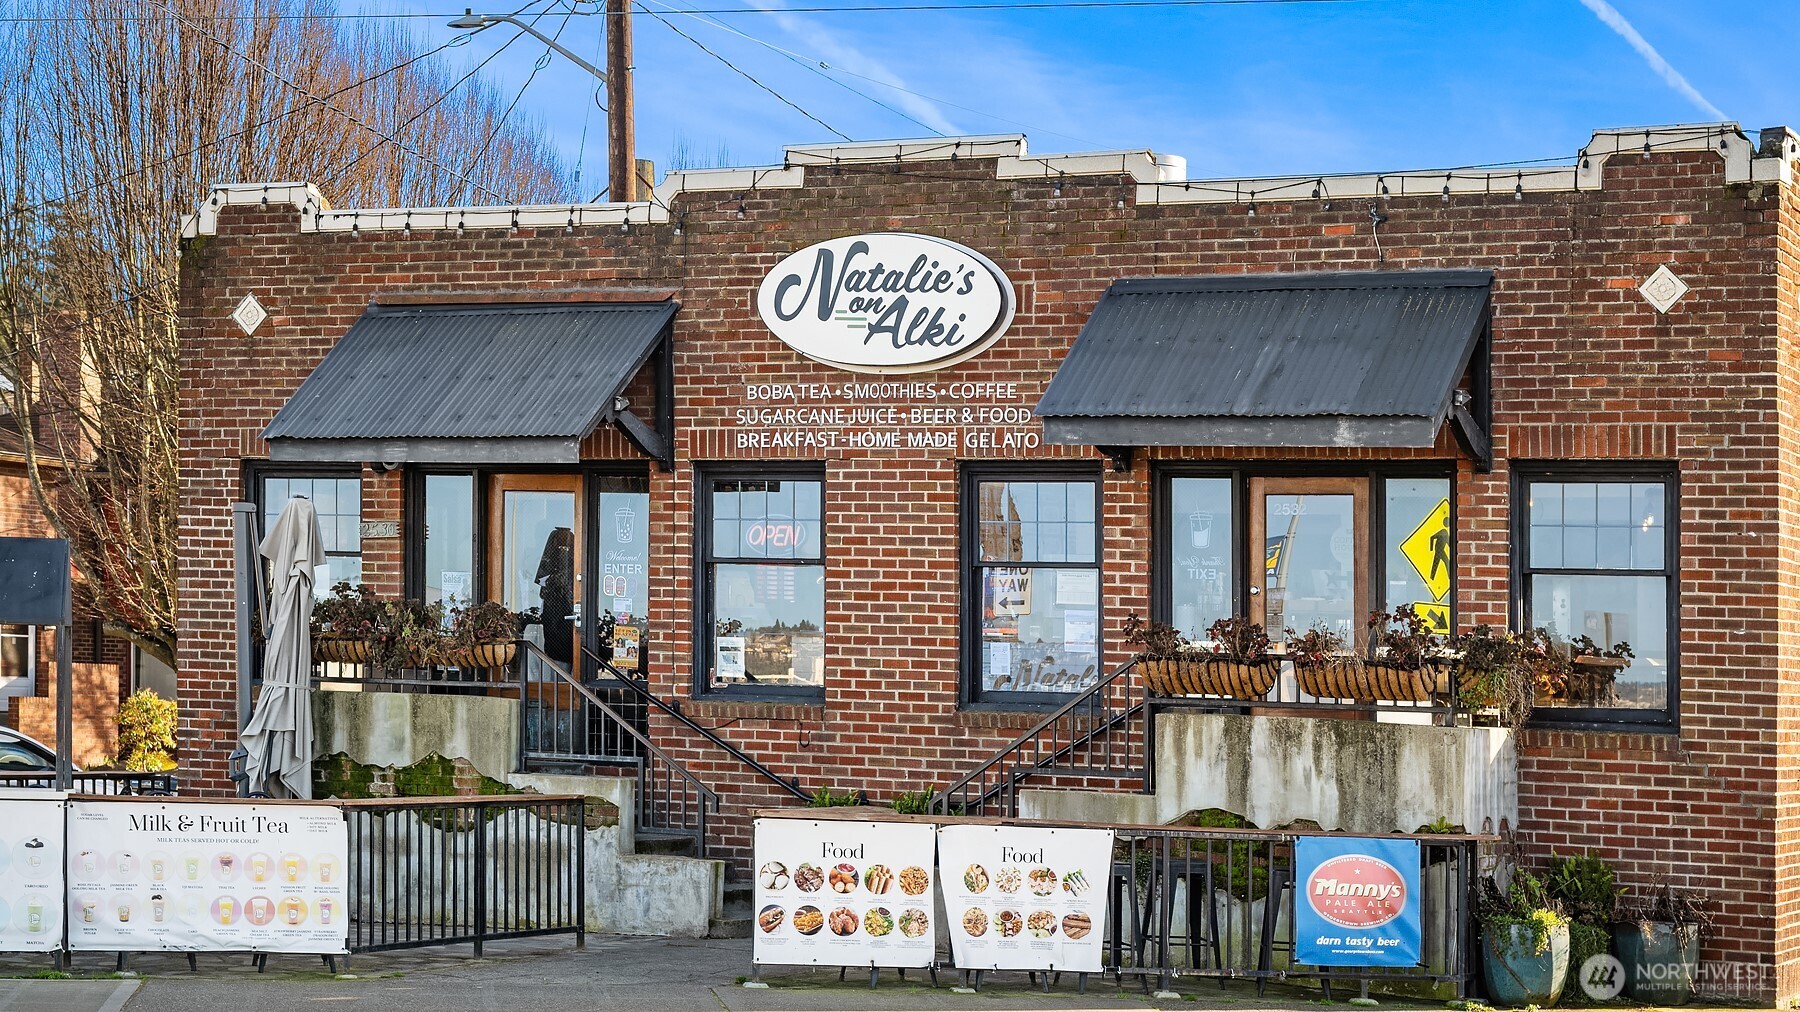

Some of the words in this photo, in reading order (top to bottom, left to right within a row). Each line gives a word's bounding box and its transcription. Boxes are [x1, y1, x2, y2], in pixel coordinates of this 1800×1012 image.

[774, 241, 975, 321] Natalie's
[849, 295, 886, 315] on
[864, 295, 966, 349] Alki
[746, 385, 794, 400] BOBA
[798, 384, 832, 399] TEA
[843, 383, 936, 399] SMOOTHIES
[949, 383, 1018, 399] COFFEE
[736, 408, 846, 424] SUGARCANE
[849, 408, 898, 424] JUICE
[911, 408, 956, 424] BEER
[961, 408, 974, 423] &
[979, 408, 1031, 424] FOOD
[737, 432, 840, 448] BREAKFAST
[849, 432, 901, 448] HOME
[907, 432, 958, 448] MADE
[965, 432, 1040, 448] GELATO
[749, 524, 801, 547] OPEN
[605, 549, 642, 563] Welcome!
[604, 563, 643, 575] ENTER
[443, 573, 462, 584] Salsa
[129, 814, 172, 832] Milk
[177, 815, 194, 833] &
[200, 815, 247, 833] Fruit
[252, 816, 289, 834] Tea
[821, 841, 864, 860] Food
[1001, 846, 1044, 864] Food
[1314, 878, 1402, 901] Manny's
[1325, 899, 1357, 907] PALE
[1367, 900, 1391, 908] ALE
[1316, 935, 1341, 945] darn
[1345, 935, 1374, 948] tasty
[1377, 936, 1401, 947] beer
